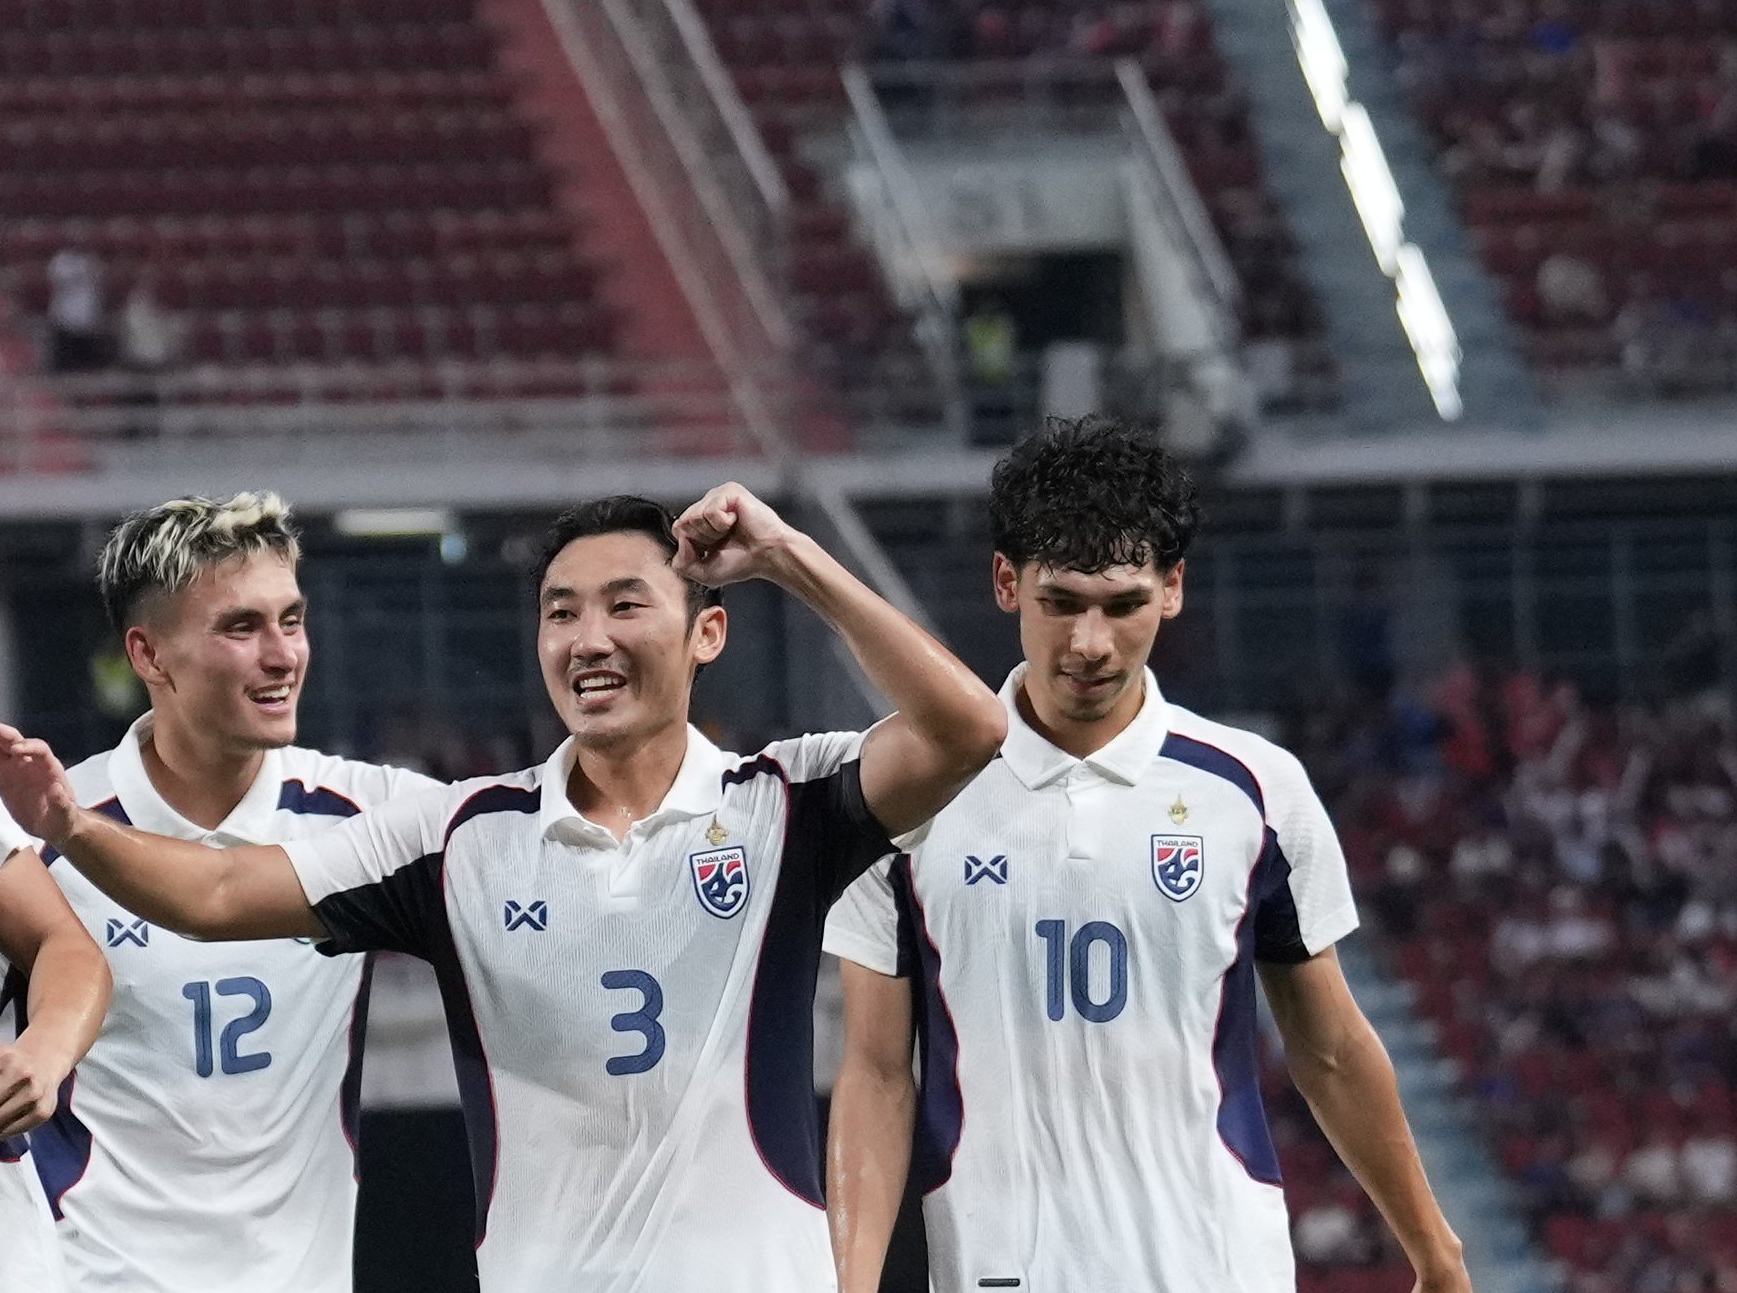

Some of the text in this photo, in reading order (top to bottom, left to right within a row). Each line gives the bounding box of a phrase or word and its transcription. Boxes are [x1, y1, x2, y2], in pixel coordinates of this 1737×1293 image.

[696, 852, 740, 865] THAILAND
[1157, 839, 1199, 848] THAILAND
[600, 969, 666, 1076] 3
[1034, 919, 1128, 1024] 10
[182, 976, 272, 1078] 12
